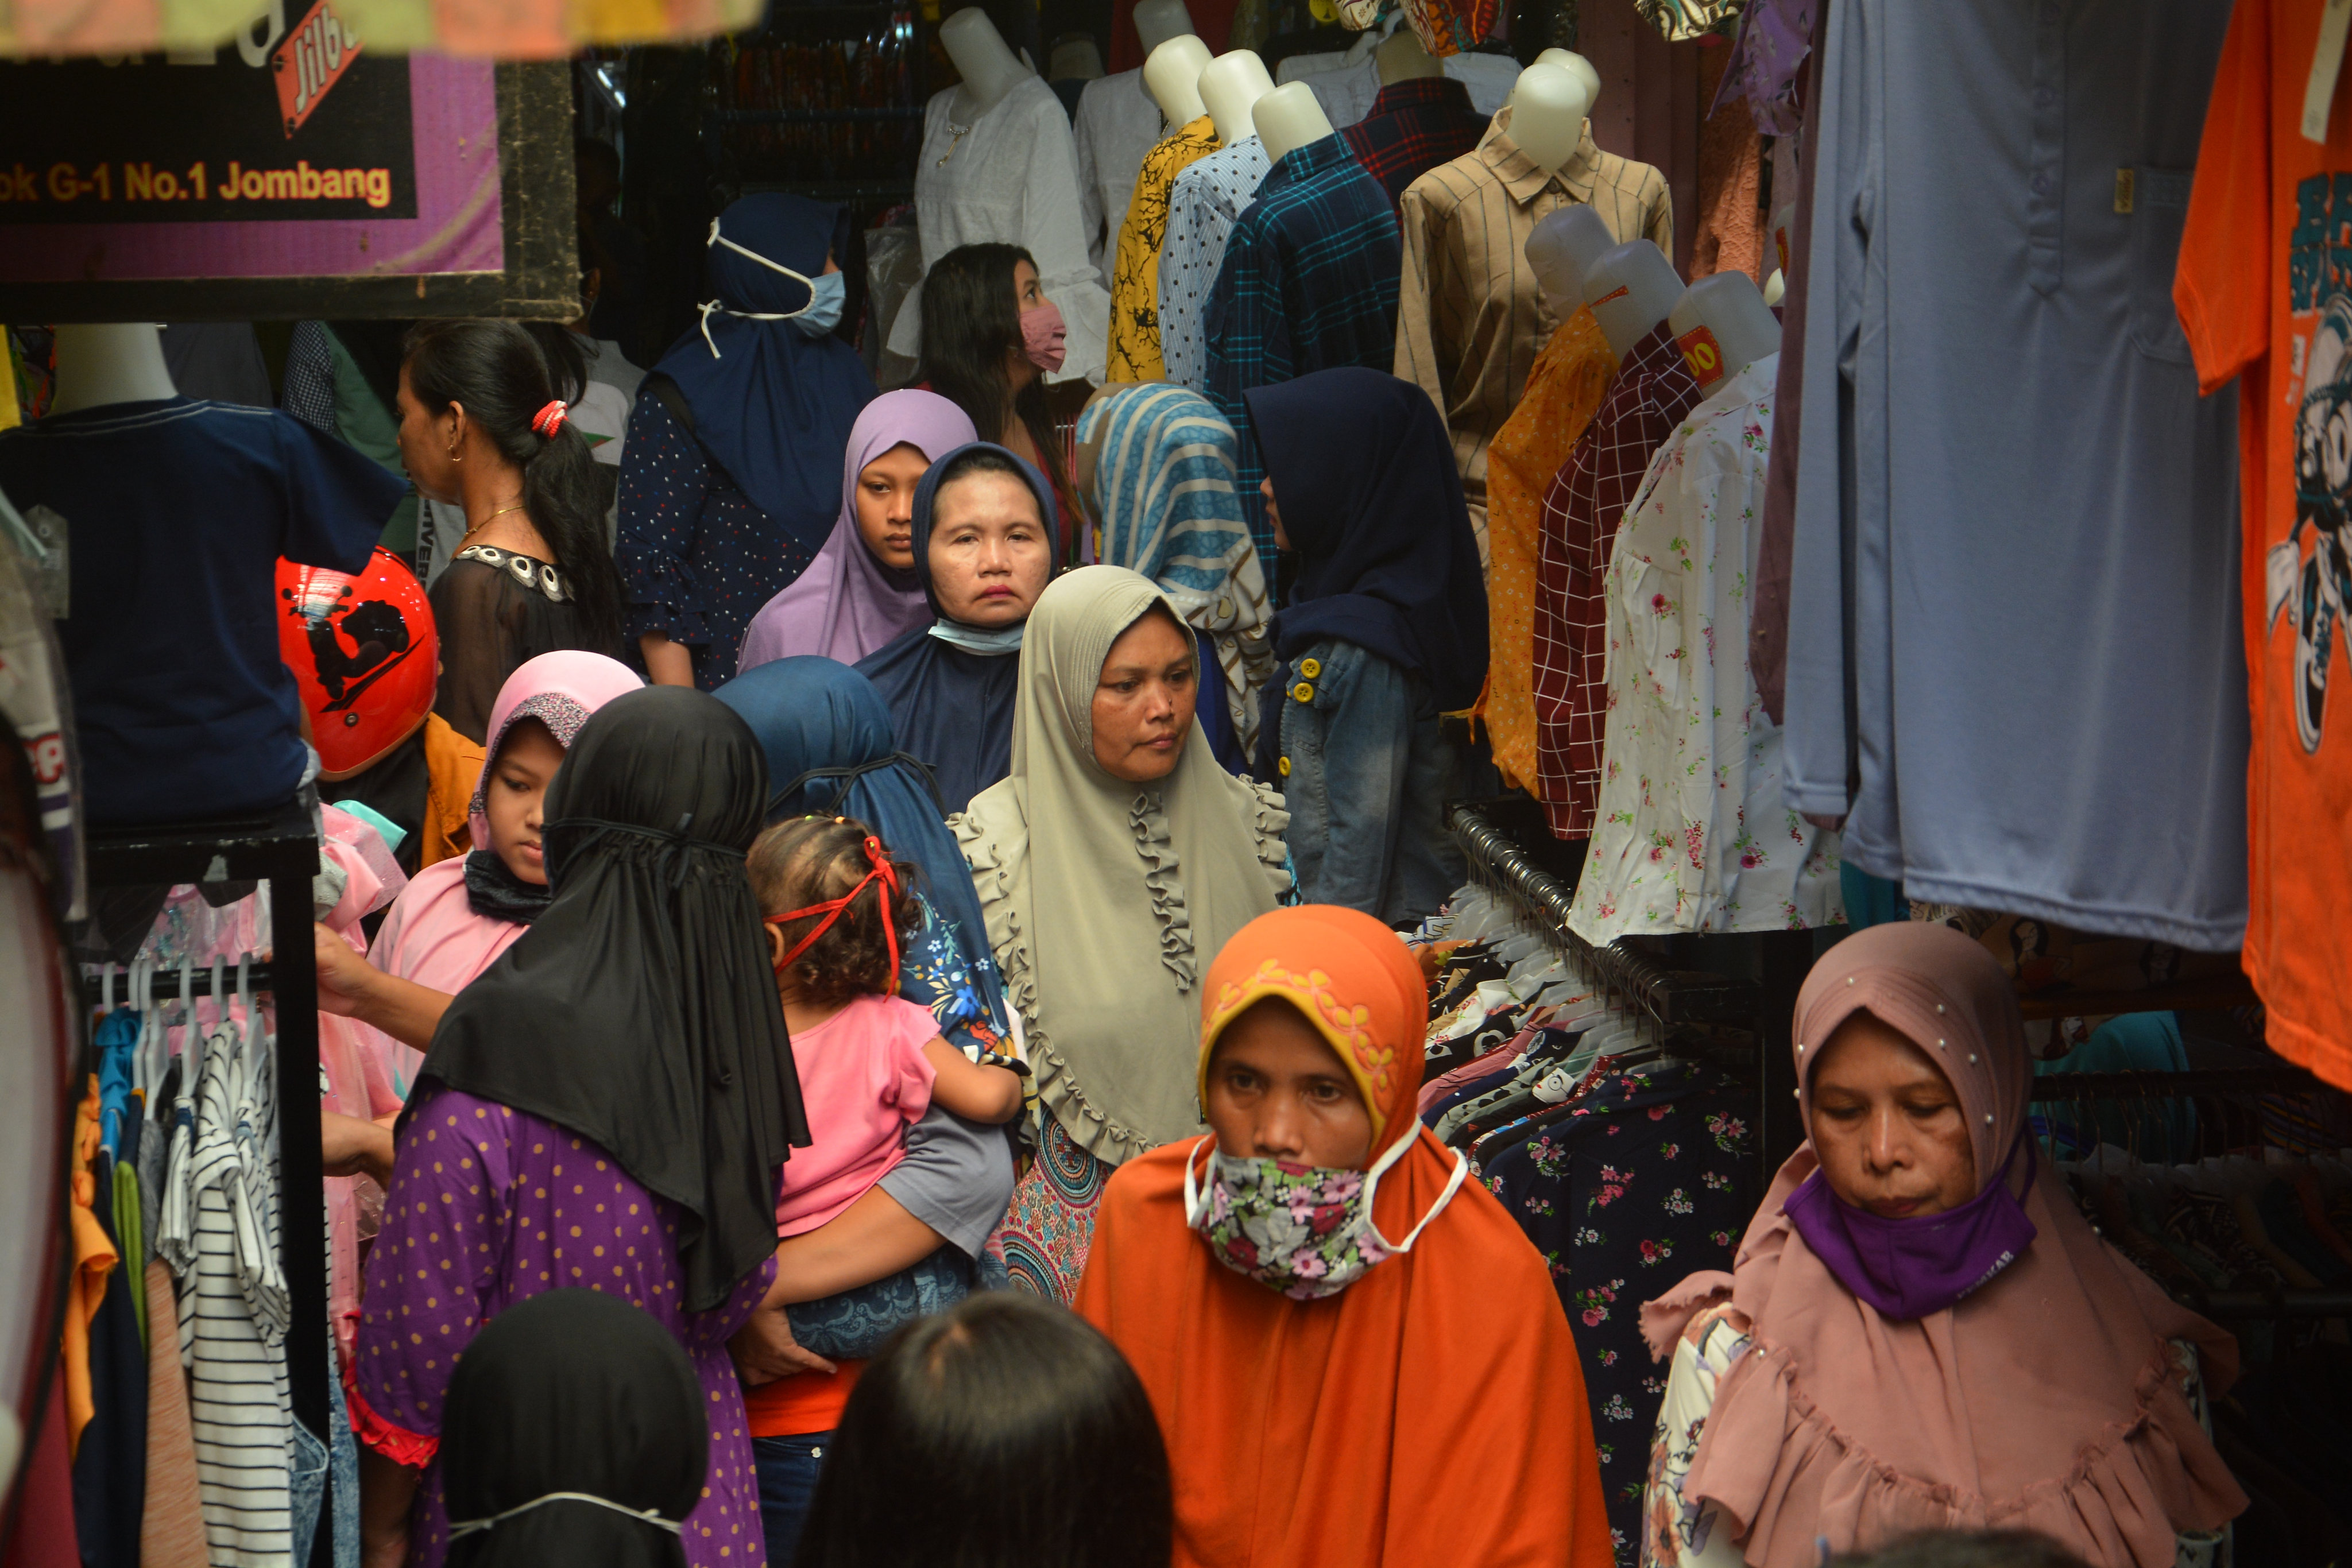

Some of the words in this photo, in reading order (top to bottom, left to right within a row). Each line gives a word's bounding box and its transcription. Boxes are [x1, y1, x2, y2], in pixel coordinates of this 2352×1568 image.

[47, 162, 112, 201] G-1
[124, 161, 207, 201] No.1
[219, 160, 391, 208] Jombang
